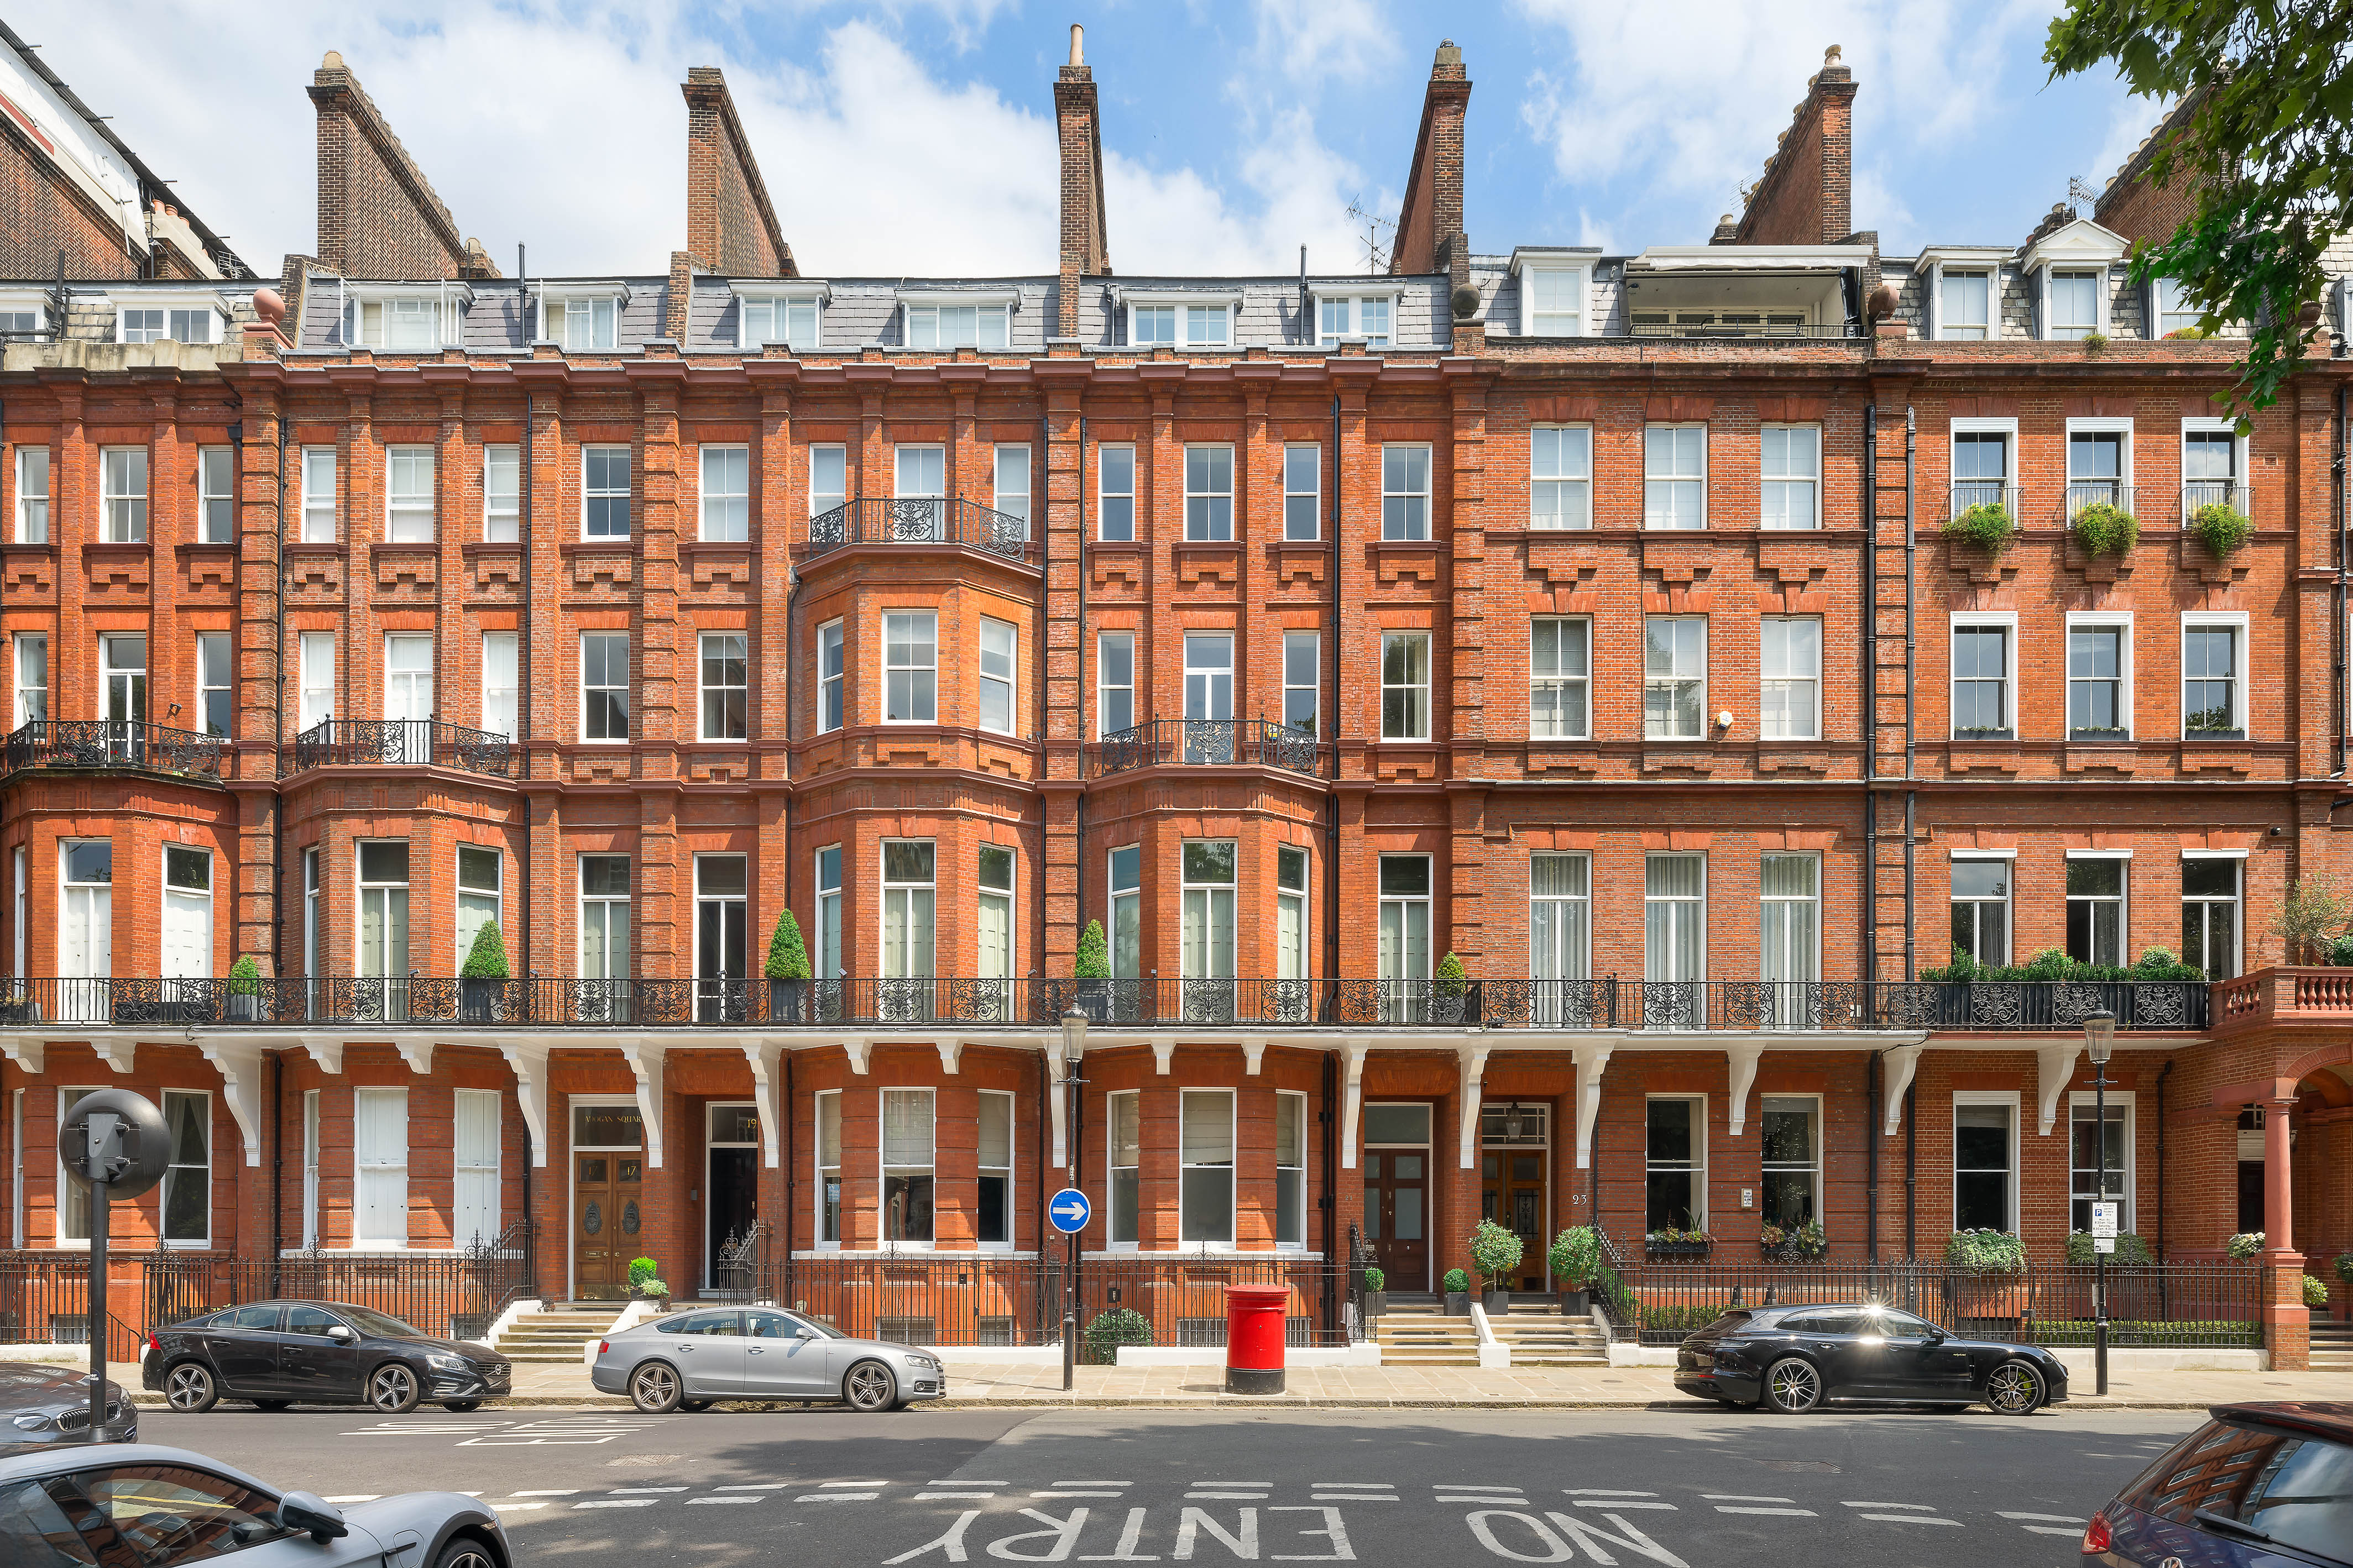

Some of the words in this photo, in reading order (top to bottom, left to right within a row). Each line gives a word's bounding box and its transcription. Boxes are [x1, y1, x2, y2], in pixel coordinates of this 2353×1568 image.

[748, 1119, 757, 1129] 19
[628, 1166, 636, 1176] 17
[1572, 1194, 1587, 1205] 23
[337, 1421, 517, 1435] NO
[453, 1417, 692, 1446] ENTRY
[881, 1506, 1357, 1565] ENTRY
[1466, 1510, 1691, 1568] NO
